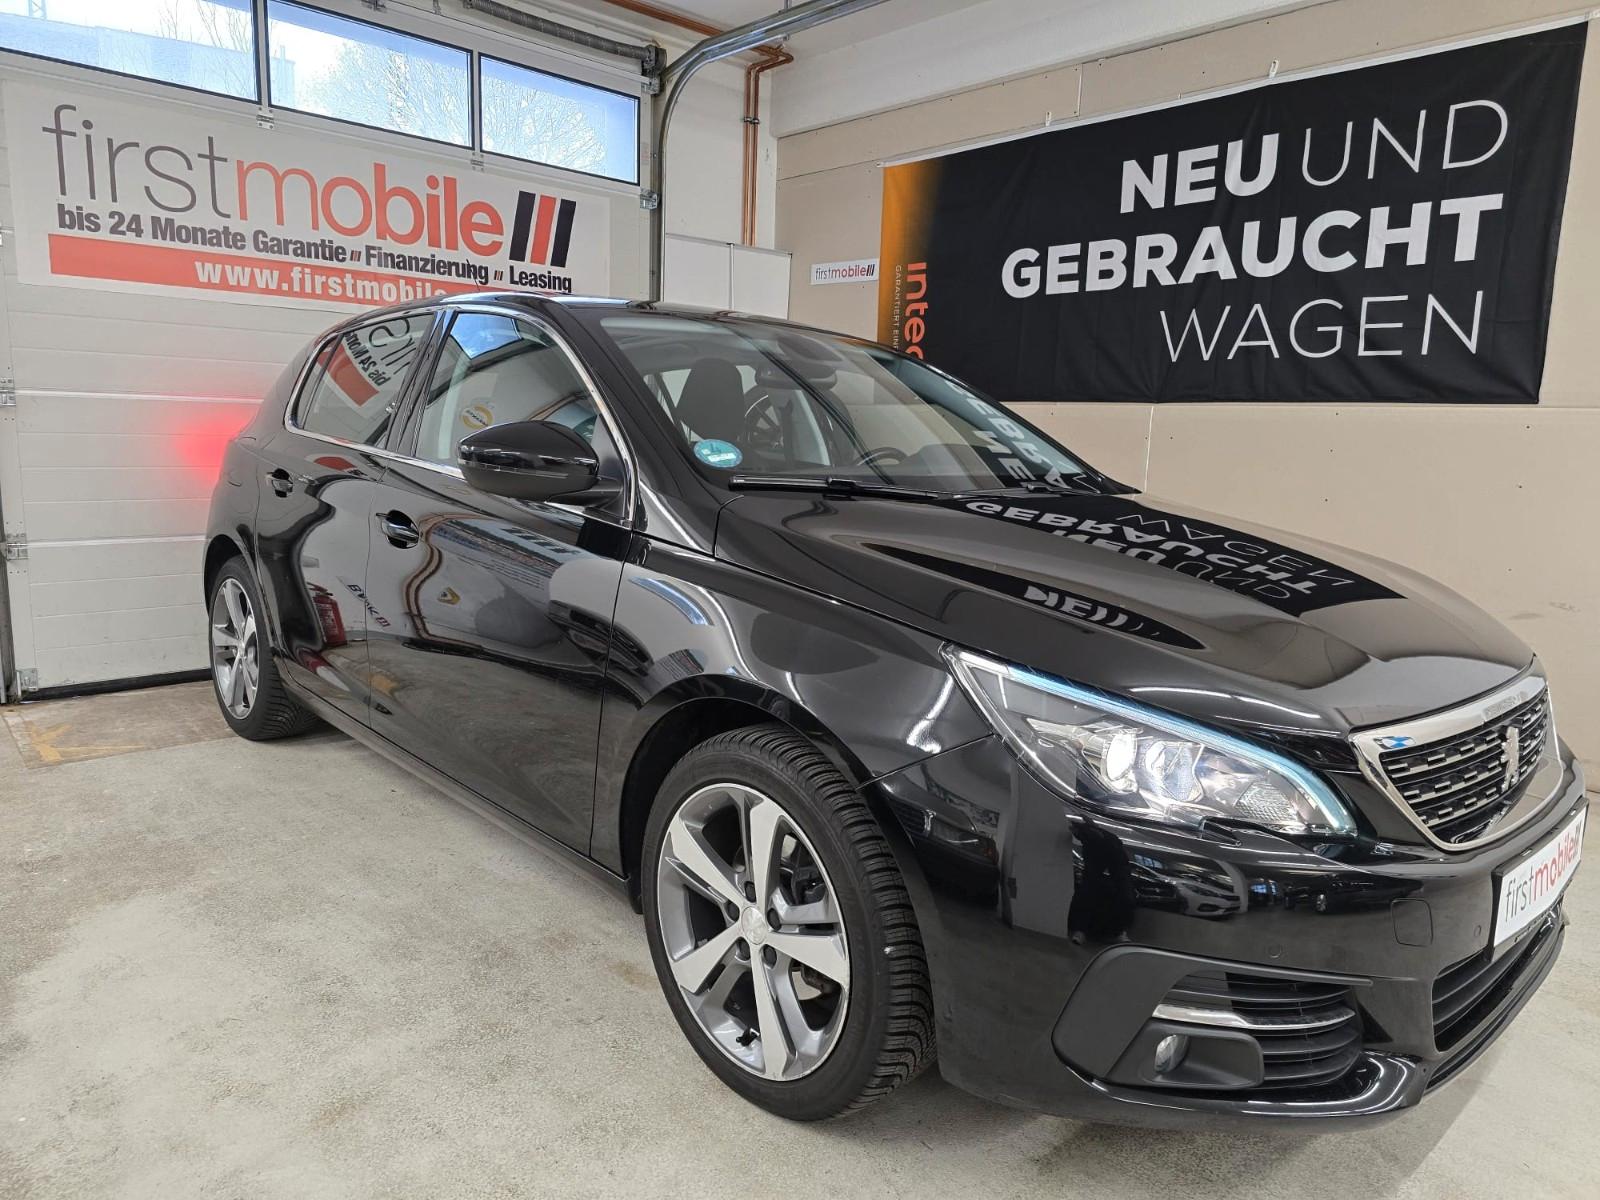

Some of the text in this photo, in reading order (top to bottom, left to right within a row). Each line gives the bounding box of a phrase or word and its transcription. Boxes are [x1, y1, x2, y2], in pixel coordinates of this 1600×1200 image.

[42, 104, 504, 257] firstmobile
[1119, 98, 1508, 214] NEU UND
[57, 203, 572, 294] bis 24 Monate Garantie Finanzierung Leasing
[815, 264, 867, 281] firstmobile
[1000, 193, 1505, 299] GEBRAUCHT
[891, 264, 902, 327] GARANTIERT
[1160, 290, 1484, 364] WAGEN
